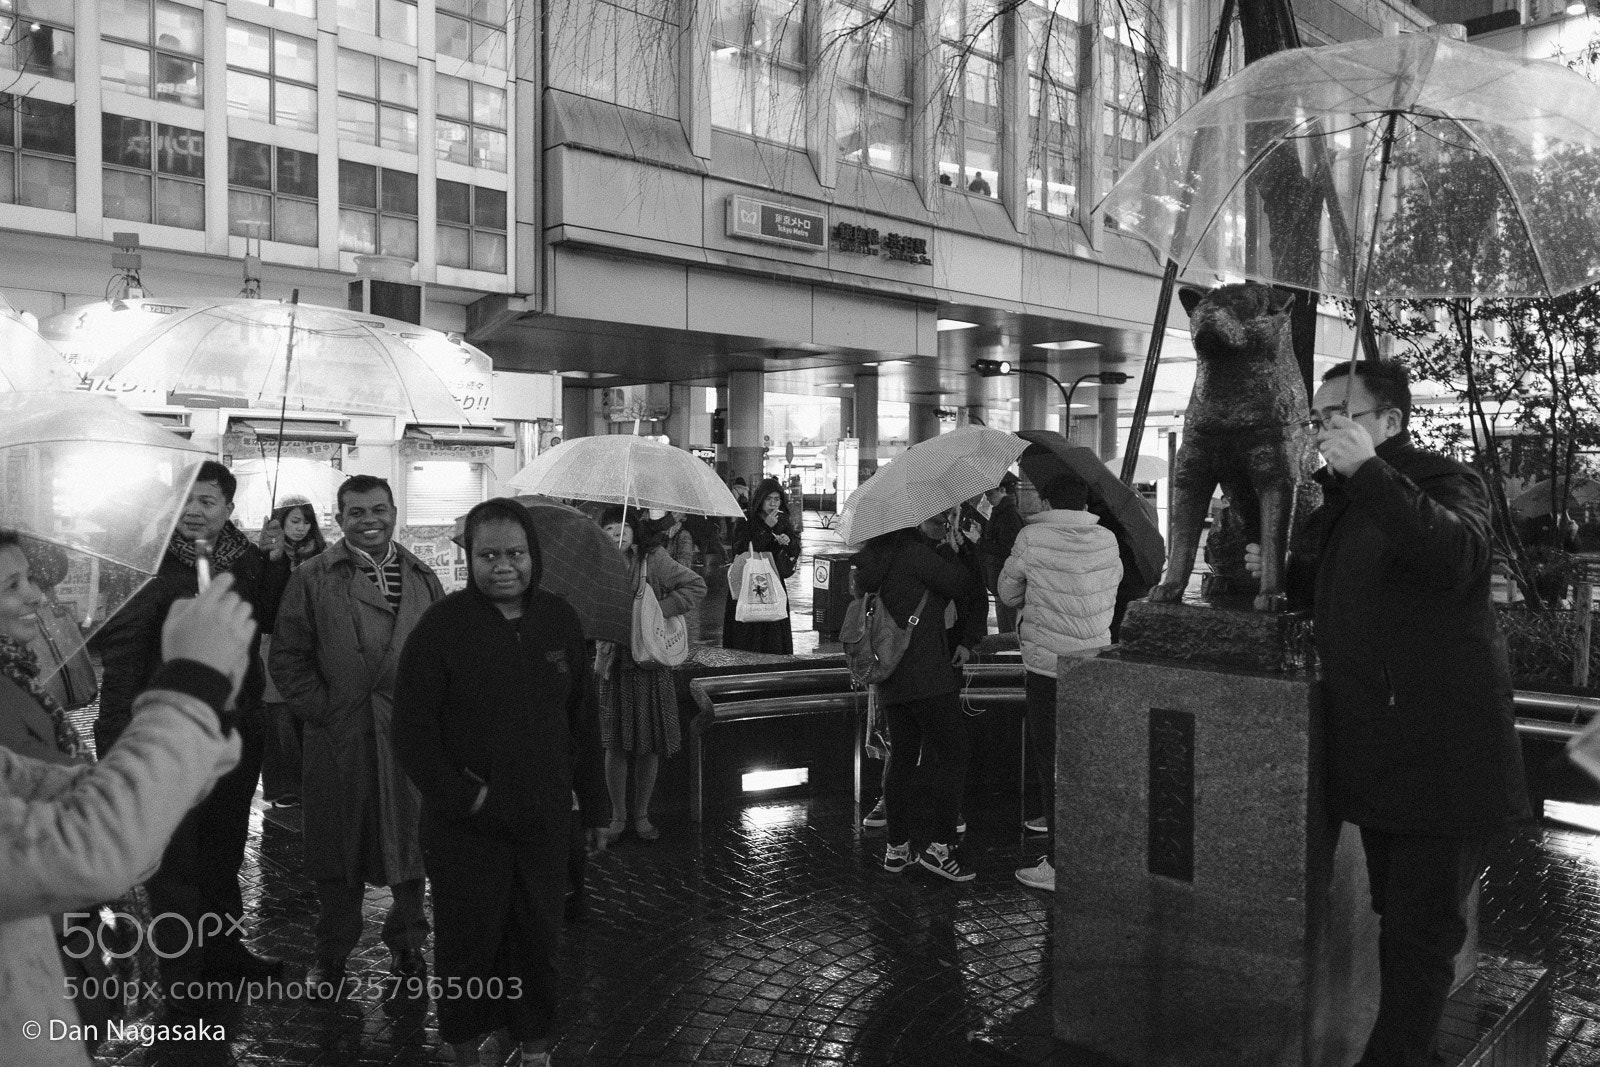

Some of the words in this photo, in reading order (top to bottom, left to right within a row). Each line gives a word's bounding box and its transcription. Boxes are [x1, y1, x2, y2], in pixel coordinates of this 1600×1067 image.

[775, 213, 810, 229] 東京メトロ
[793, 228, 809, 237] Metro
